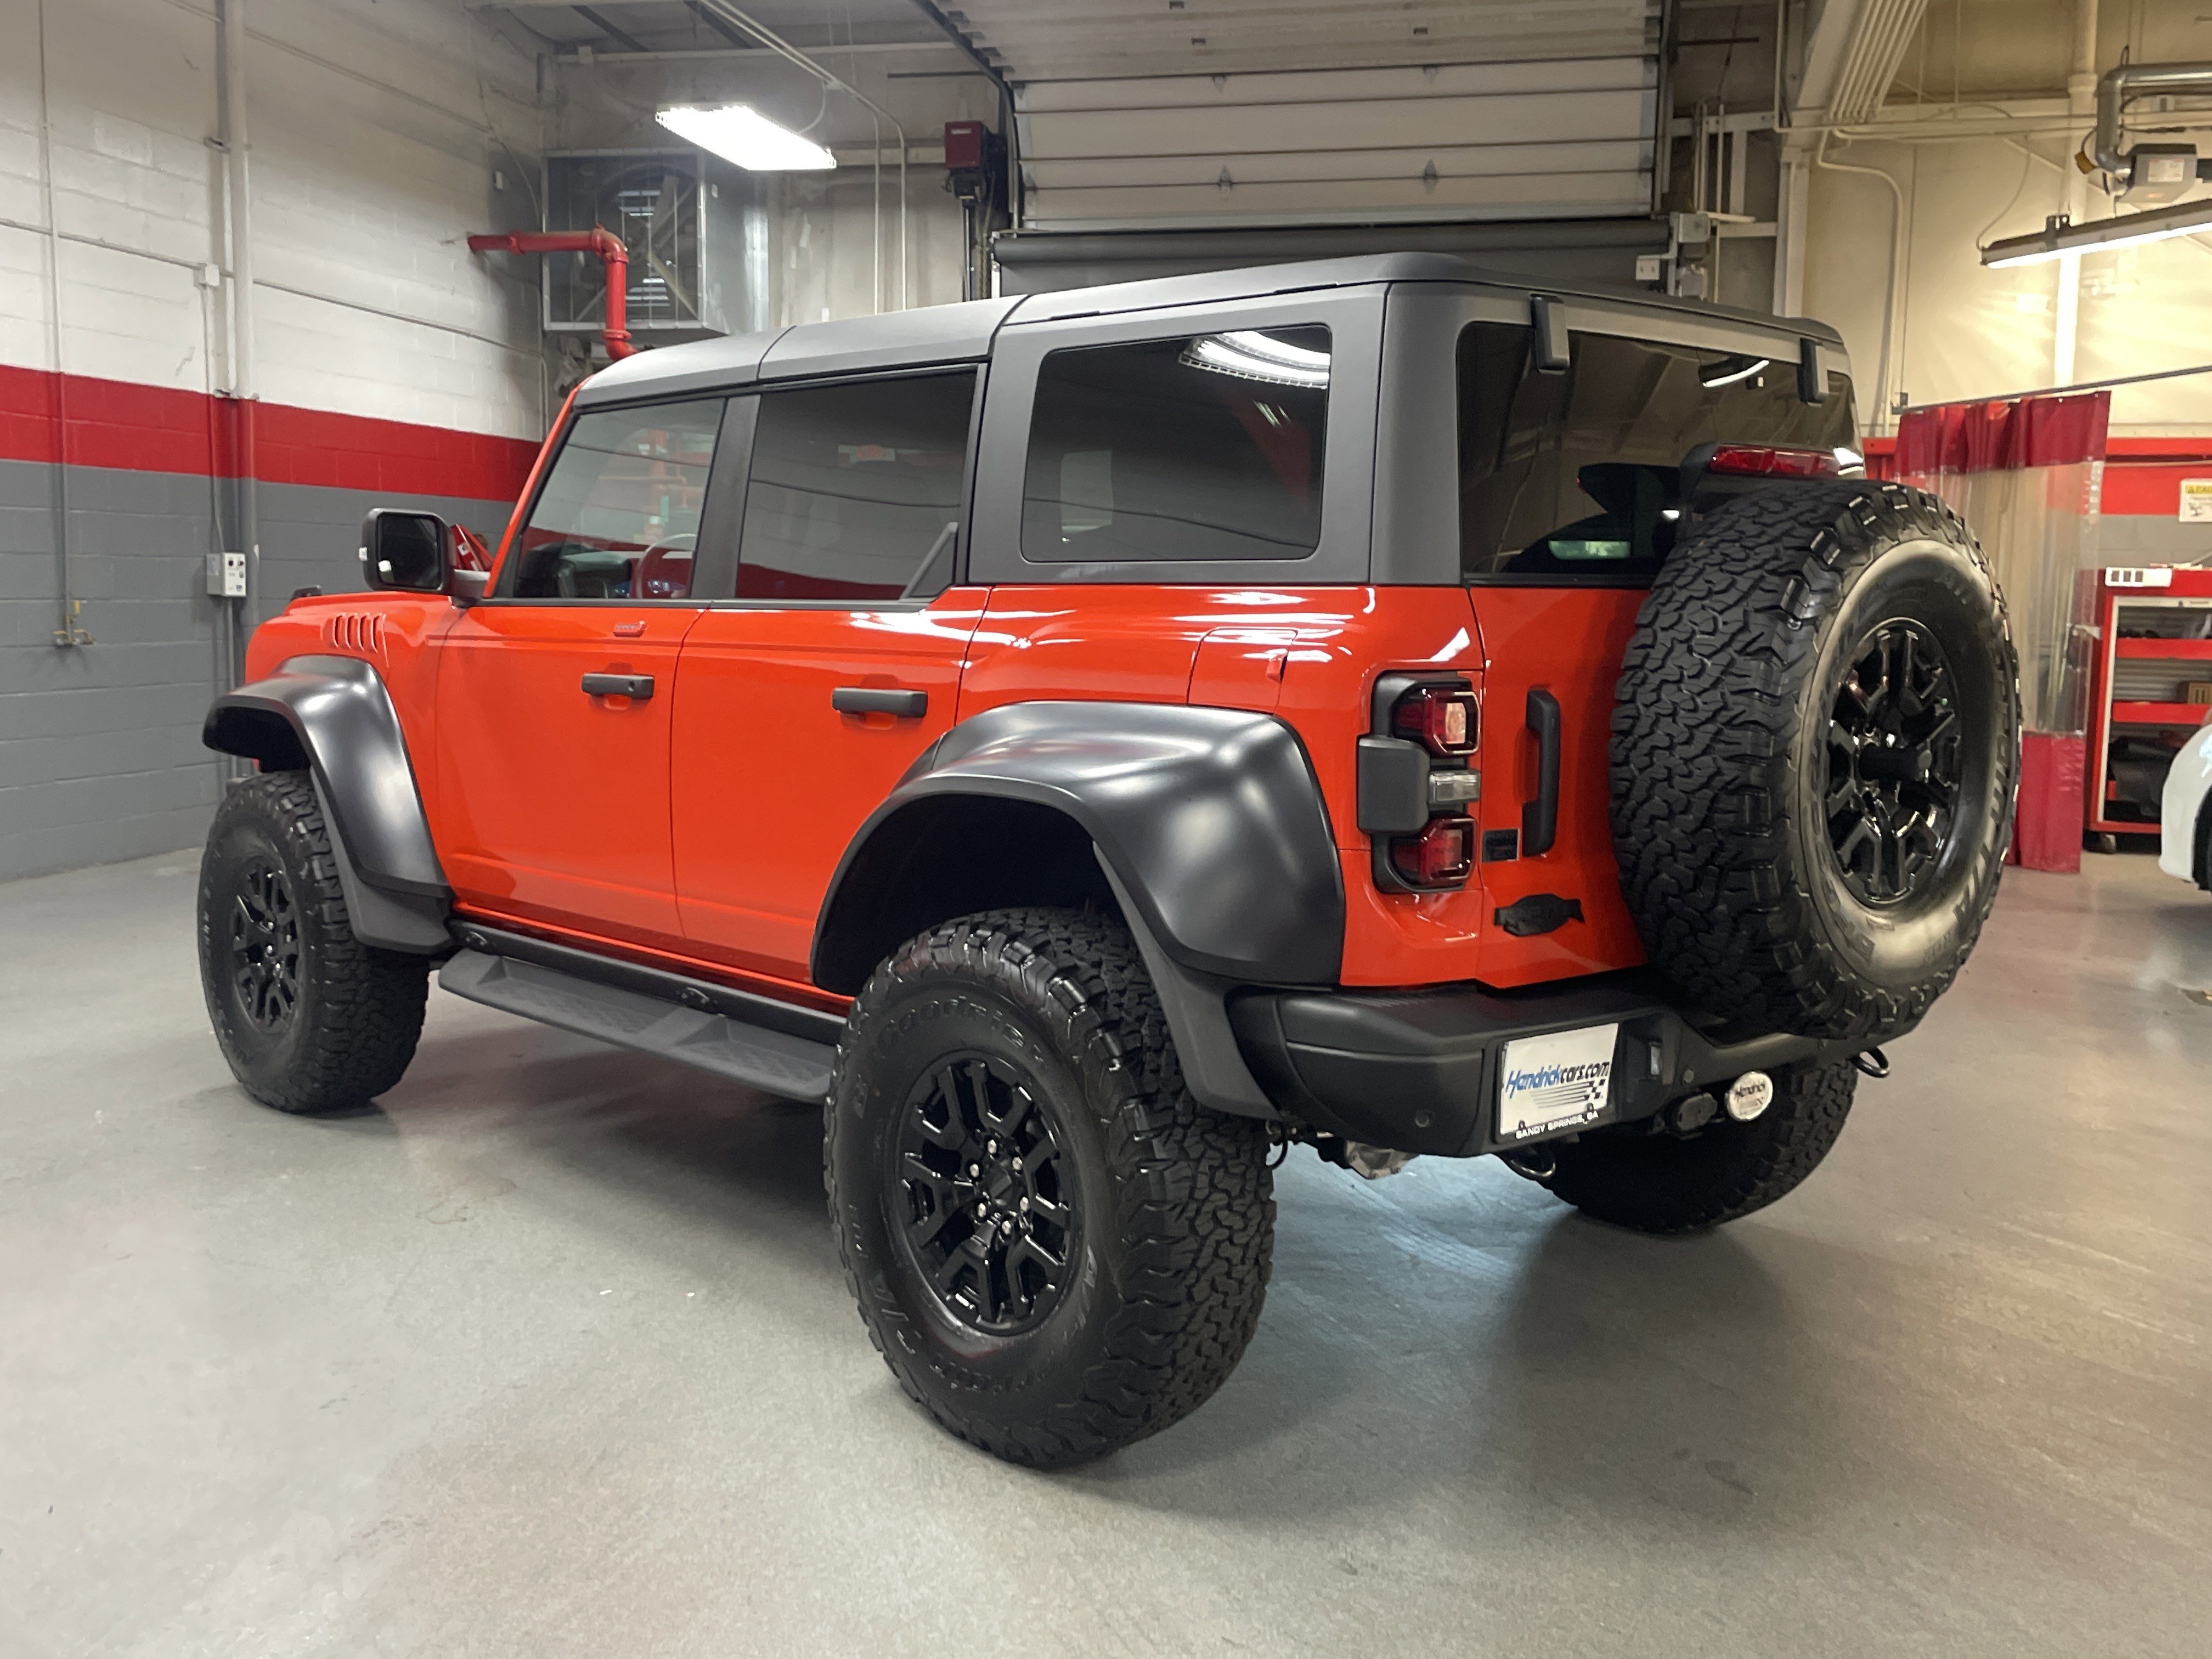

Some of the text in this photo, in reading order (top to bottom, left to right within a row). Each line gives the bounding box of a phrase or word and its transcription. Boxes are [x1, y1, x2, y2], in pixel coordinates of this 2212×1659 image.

[1505, 1062, 1610, 1099] Hendrickcars.com
[1515, 1124, 1546, 1139] SANDY
[1586, 1110, 1599, 1120] GA
